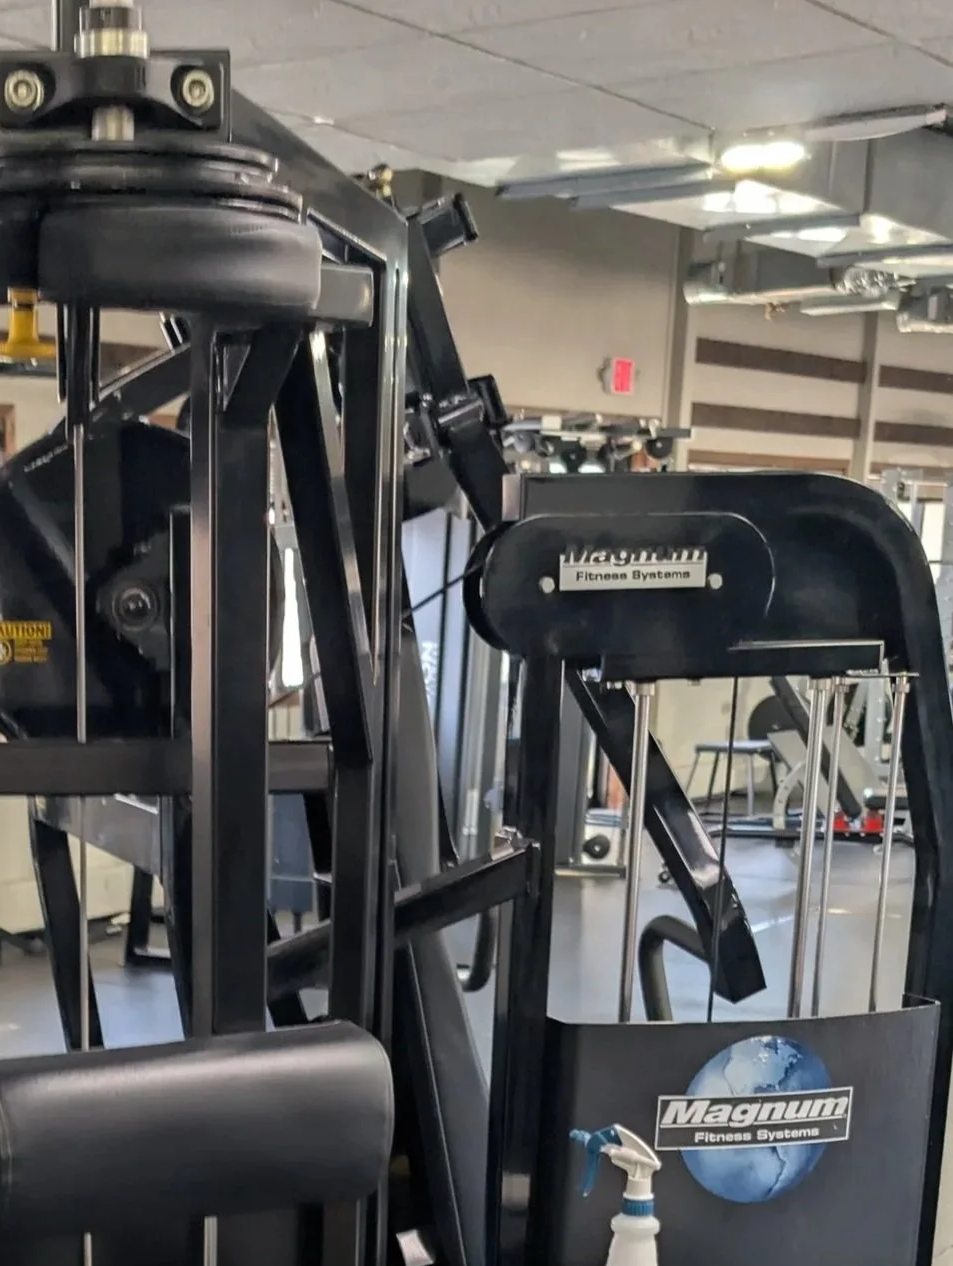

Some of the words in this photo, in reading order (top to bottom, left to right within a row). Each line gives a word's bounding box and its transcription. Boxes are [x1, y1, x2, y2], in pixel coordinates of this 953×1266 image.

[575, 571, 628, 582] Fitness
[631, 569, 691, 581] Systems
[660, 1096, 849, 1127] Magnum
[694, 1131, 752, 1144] Fitness
[756, 1127, 820, 1142] Systems
